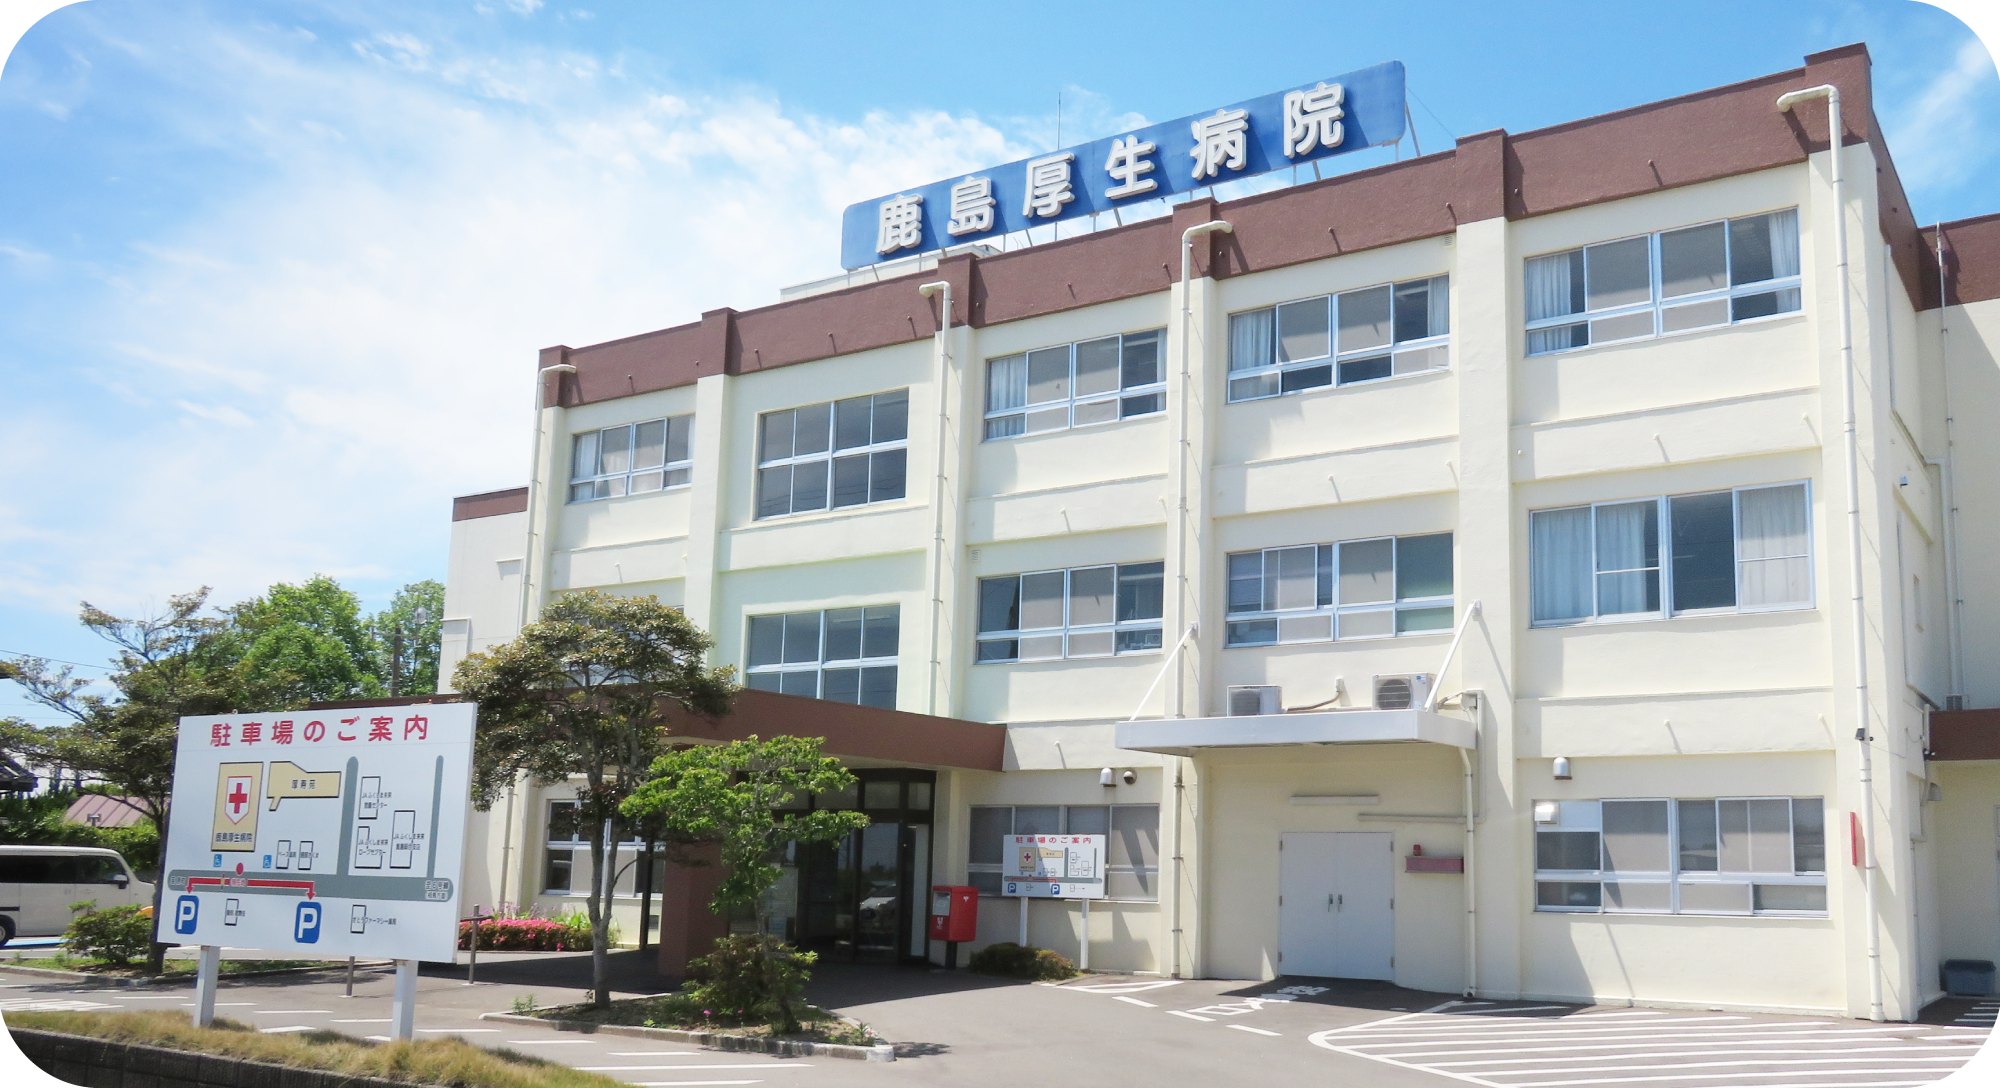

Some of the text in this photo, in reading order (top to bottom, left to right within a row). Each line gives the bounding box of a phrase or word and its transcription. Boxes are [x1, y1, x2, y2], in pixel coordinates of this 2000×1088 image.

[876, 82, 1345, 254] 鹿島厚生病院
[210, 715, 429, 747] 駐車場のご案内
[1015, 836, 1092, 844] 駐車場のご案内
[177, 900, 196, 930] P
[297, 907, 318, 939] P
